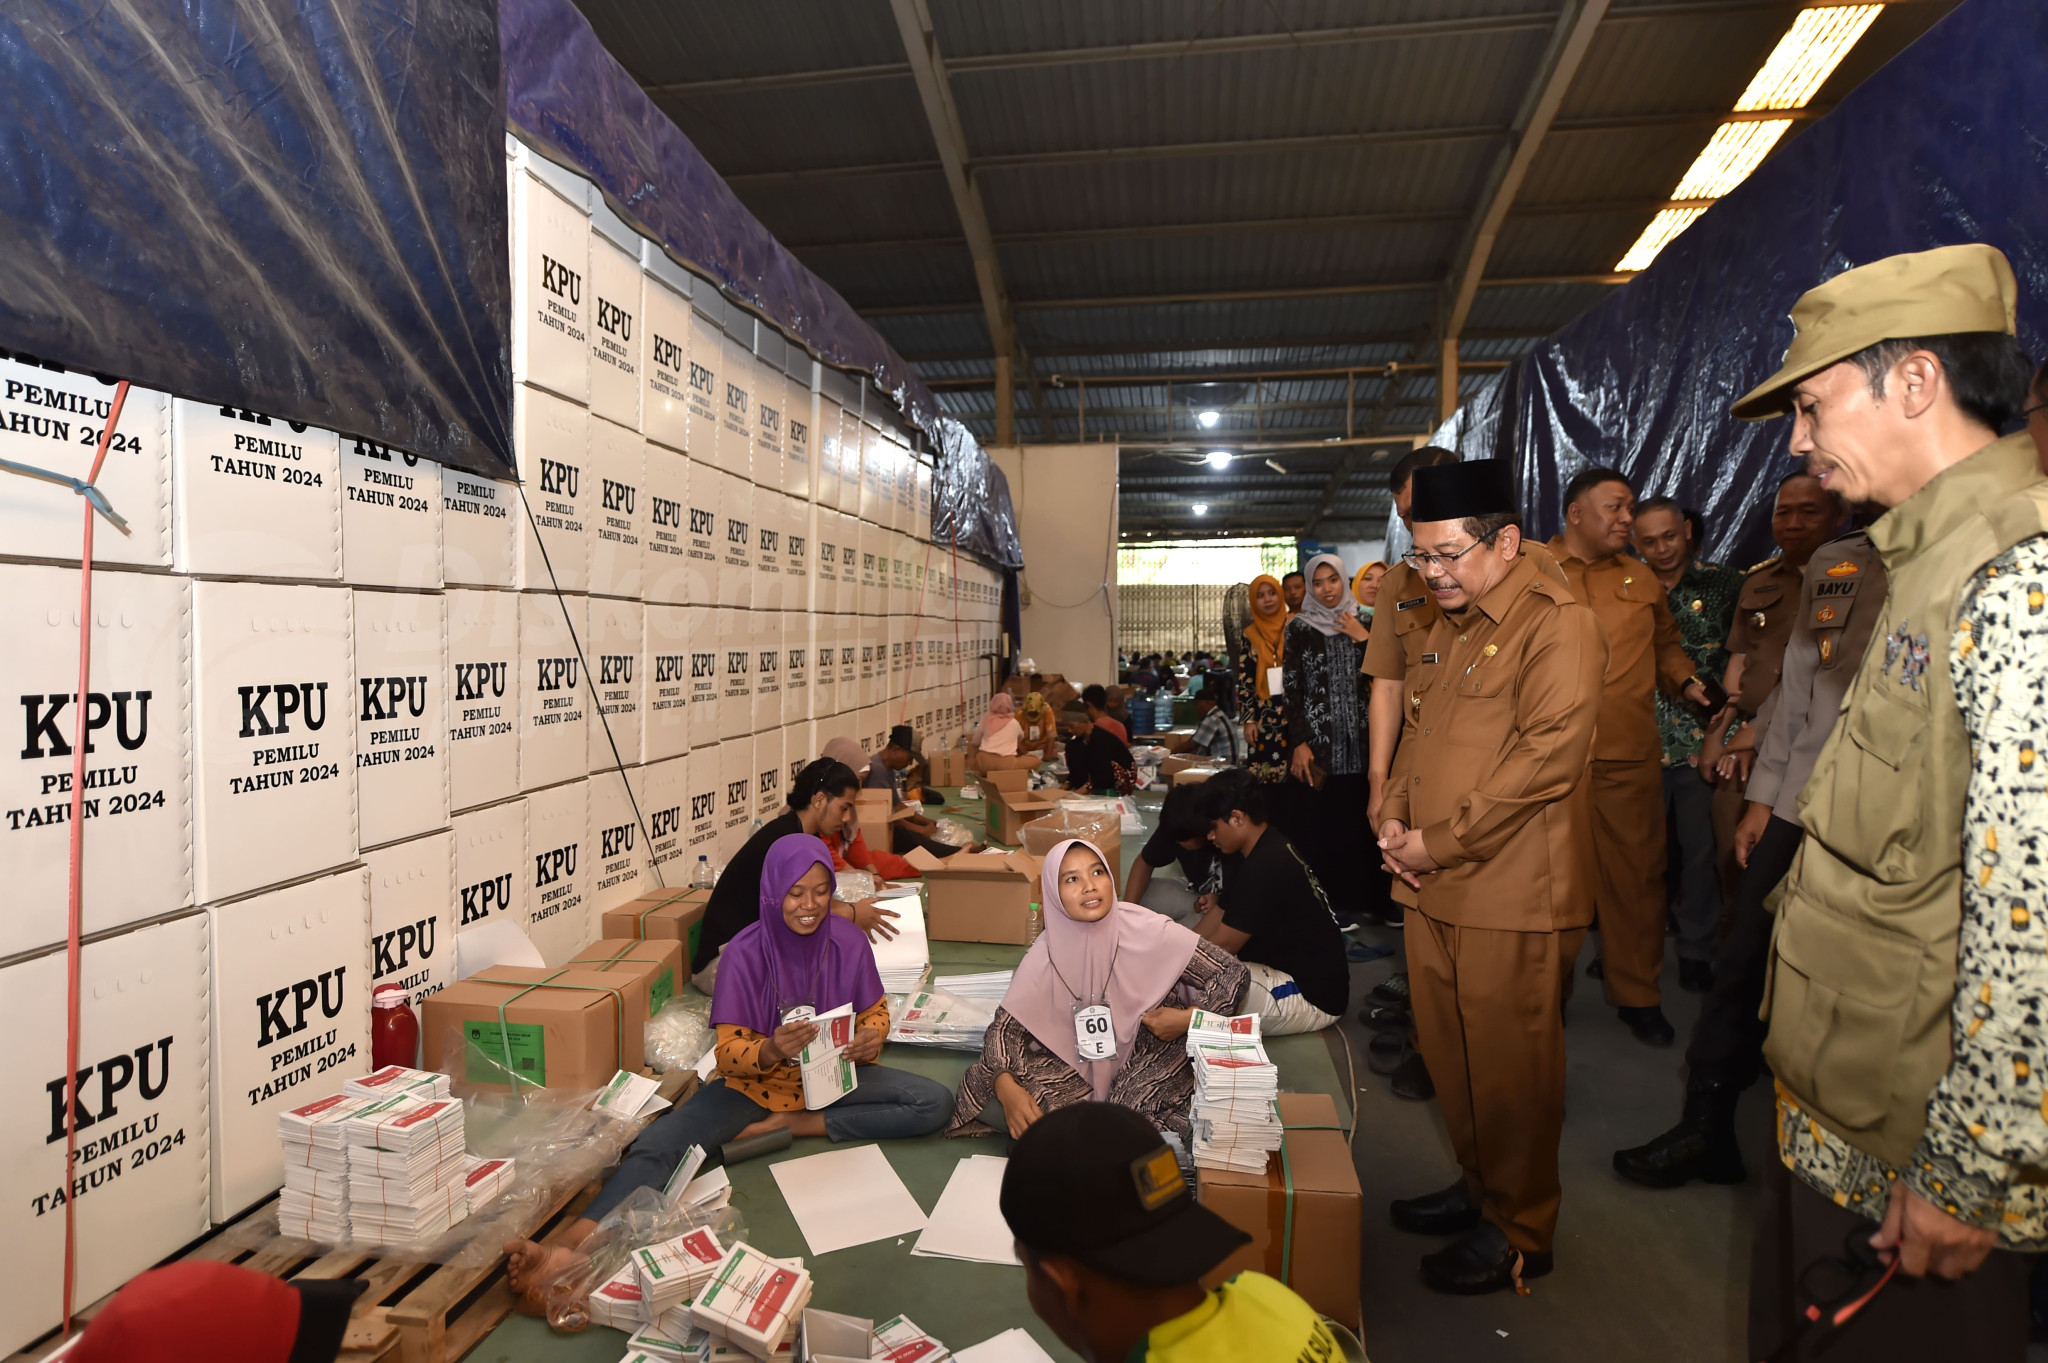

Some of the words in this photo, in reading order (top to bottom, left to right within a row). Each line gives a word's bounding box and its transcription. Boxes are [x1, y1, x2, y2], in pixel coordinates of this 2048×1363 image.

[541, 254, 581, 307] KPU
[547, 299, 576, 324] PEMILU
[597, 297, 631, 343] KPU
[538, 310, 564, 333] TAHUN
[566, 325, 584, 342] 2024
[653, 334, 682, 374] KPU
[690, 361, 714, 397] KPU
[5, 379, 111, 419] PEMILU
[726, 382, 747, 414] KPU
[790, 419, 806, 445] KPU
[233, 433, 303, 461] PEMILU
[210, 455, 275, 481] TAHUN
[280, 467, 322, 487] 2024
[363, 467, 413, 489] PEMILU
[540, 458, 578, 499] KPU
[347, 487, 393, 507] TAHUN
[397, 495, 428, 512] 2024
[456, 480, 495, 499] PEMILU
[601, 479, 635, 515] KPU
[443, 497, 479, 515] TAHUN
[482, 504, 506, 518] 2024
[545, 501, 574, 516] PEMILU
[652, 497, 680, 529] KPU
[535, 515, 562, 529] TAHUN
[564, 520, 582, 532] 2024
[689, 508, 713, 536] KPU
[727, 519, 748, 544] KPU
[760, 529, 778, 553] KPU
[788, 535, 804, 557] KPU
[1817, 582, 1854, 596] BAYU
[600, 655, 633, 685] KPU
[655, 655, 683, 682] KPU
[691, 653, 715, 677] KPU
[727, 652, 748, 674] KPU
[759, 651, 777, 672] KPU
[789, 649, 804, 669] KPU
[455, 662, 506, 700] KPU
[537, 657, 578, 691] KPU
[237, 682, 328, 738] KPU
[359, 676, 426, 721] KPU
[543, 696, 573, 709] PEMILU
[20, 691, 152, 759] KPU
[462, 706, 500, 721] PEMILU
[533, 713, 561, 725] TAHUN
[563, 710, 581, 722] 2024
[369, 727, 419, 745] PEMILU
[449, 726, 485, 741] TAHUN
[488, 722, 511, 736] 2024
[253, 743, 319, 766] PEMILU
[403, 745, 434, 763] 2024
[41, 766, 138, 794] PEMILU
[230, 771, 293, 794] TAHUN
[299, 763, 339, 785] 2024
[760, 768, 777, 793] KPU
[108, 790, 165, 817] 2024
[691, 791, 714, 821] KPU
[727, 779, 747, 806] KPU
[651, 806, 680, 840] KPU
[601, 822, 635, 859] KPU
[535, 843, 577, 887] KPU
[460, 873, 511, 928] KPU
[541, 883, 572, 903] PEMILU
[531, 903, 559, 921] TAHUN
[561, 894, 581, 911] 2024
[372, 916, 436, 983] KPU
[398, 969, 429, 990] MILU
[256, 966, 345, 1049] KPU
[1086, 1017, 1107, 1034] 60
[270, 1028, 336, 1072] PEMILU
[1096, 1042, 1104, 1053] E
[248, 1064, 310, 1106] TAHUN
[316, 1041, 356, 1075] 2024
[45, 1036, 172, 1145] KPU
[32, 1158, 122, 1217] TAHUN
[130, 1127, 185, 1171] 2024
